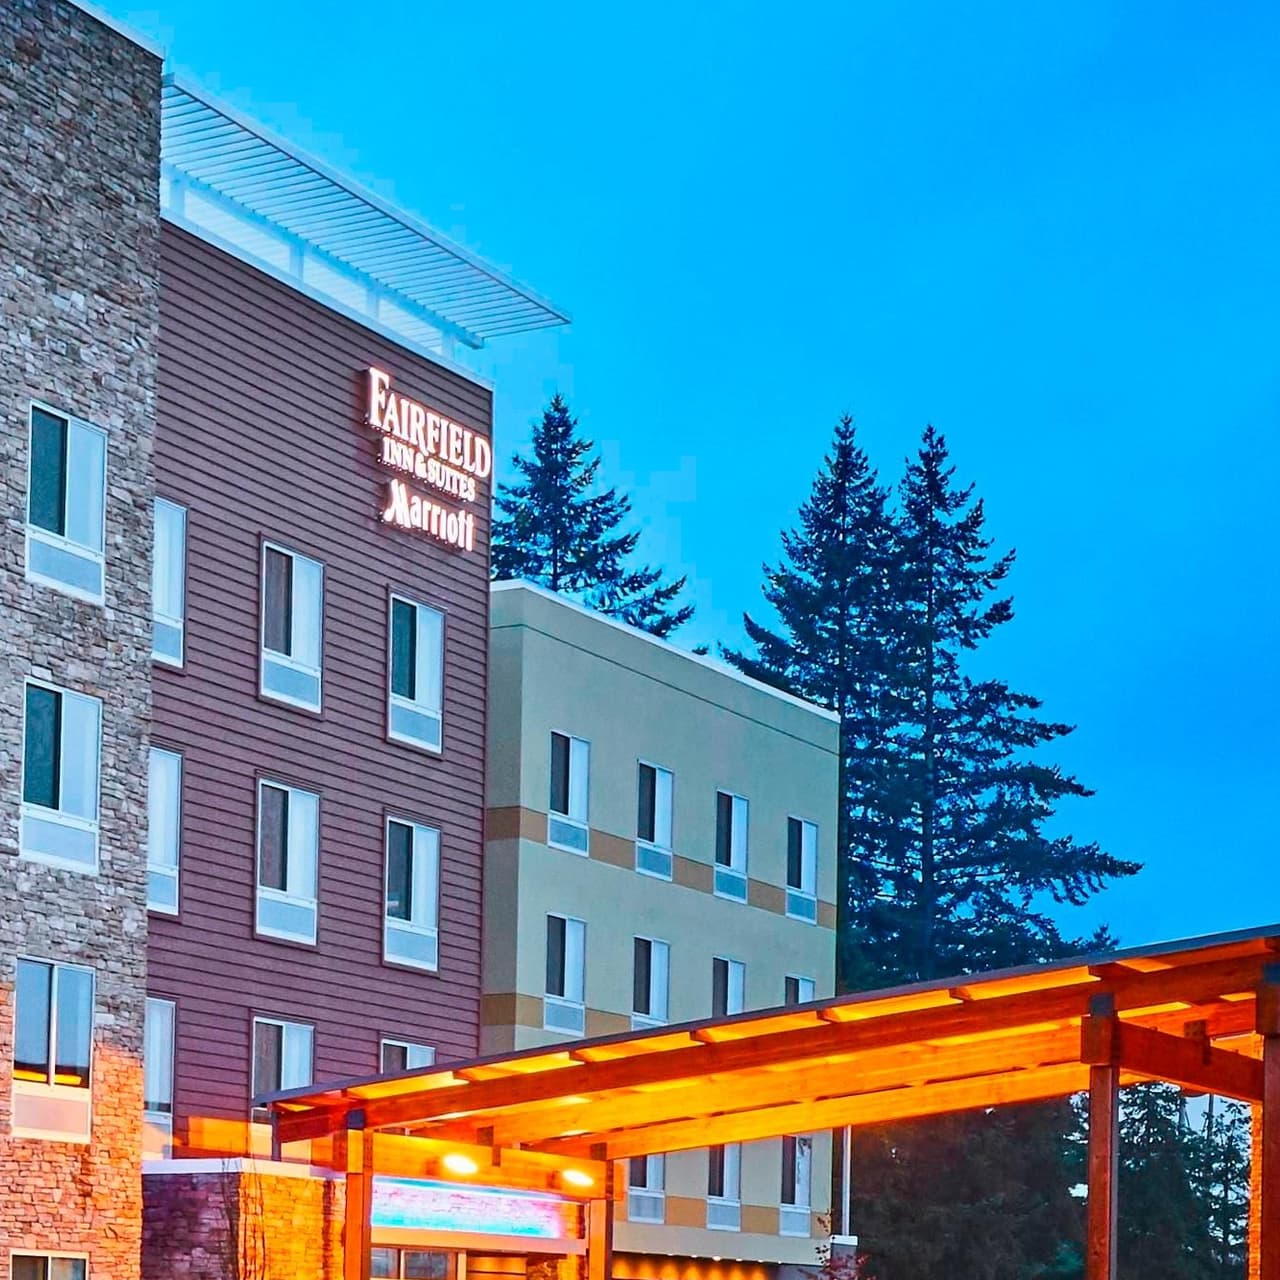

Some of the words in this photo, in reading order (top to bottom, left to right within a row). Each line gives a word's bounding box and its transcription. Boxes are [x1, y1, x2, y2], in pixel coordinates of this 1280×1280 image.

[369, 367, 491, 478] FAIRFIELD
[383, 436, 415, 474] INN
[427, 459, 476, 503] SUITES
[383, 478, 475, 552] Marriott
